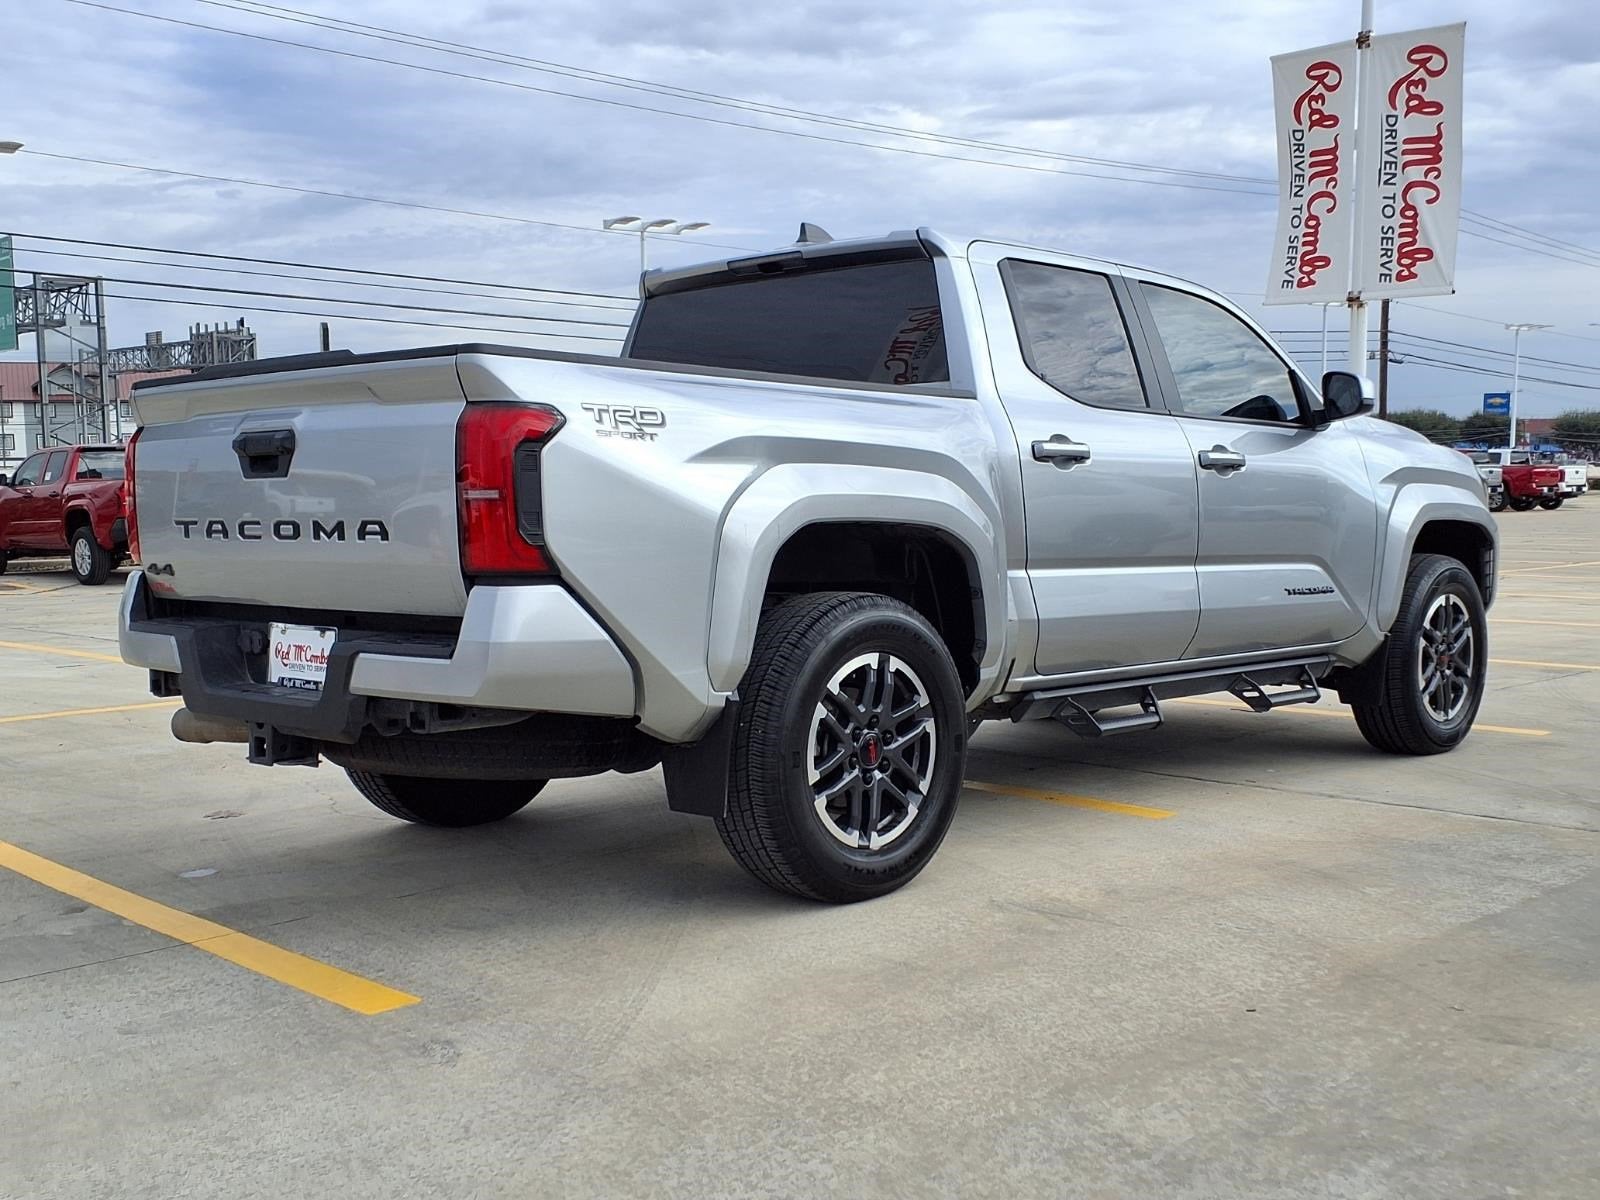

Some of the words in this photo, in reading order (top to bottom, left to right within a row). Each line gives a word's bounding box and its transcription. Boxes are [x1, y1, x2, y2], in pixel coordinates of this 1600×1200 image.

[1293, 60, 1343, 133] Red
[1387, 44, 1449, 119] Red
[1291, 129, 1305, 198] DRIVEN
[1383, 114, 1398, 187] DRIVEN
[1290, 204, 1303, 229] TO
[1296, 133, 1340, 289] McCombs
[1381, 193, 1396, 219] TO
[1395, 121, 1445, 283] McCombs
[1281, 235, 1299, 290] SERVE
[1379, 225, 1395, 284] SERVE
[580, 402, 667, 433] TRD
[595, 429, 659, 442] SPORT
[174, 519, 390, 542] TACOMA
[275, 641, 292, 667] Red
[307, 664, 313, 672] TO
[314, 665, 327, 673] SERV
